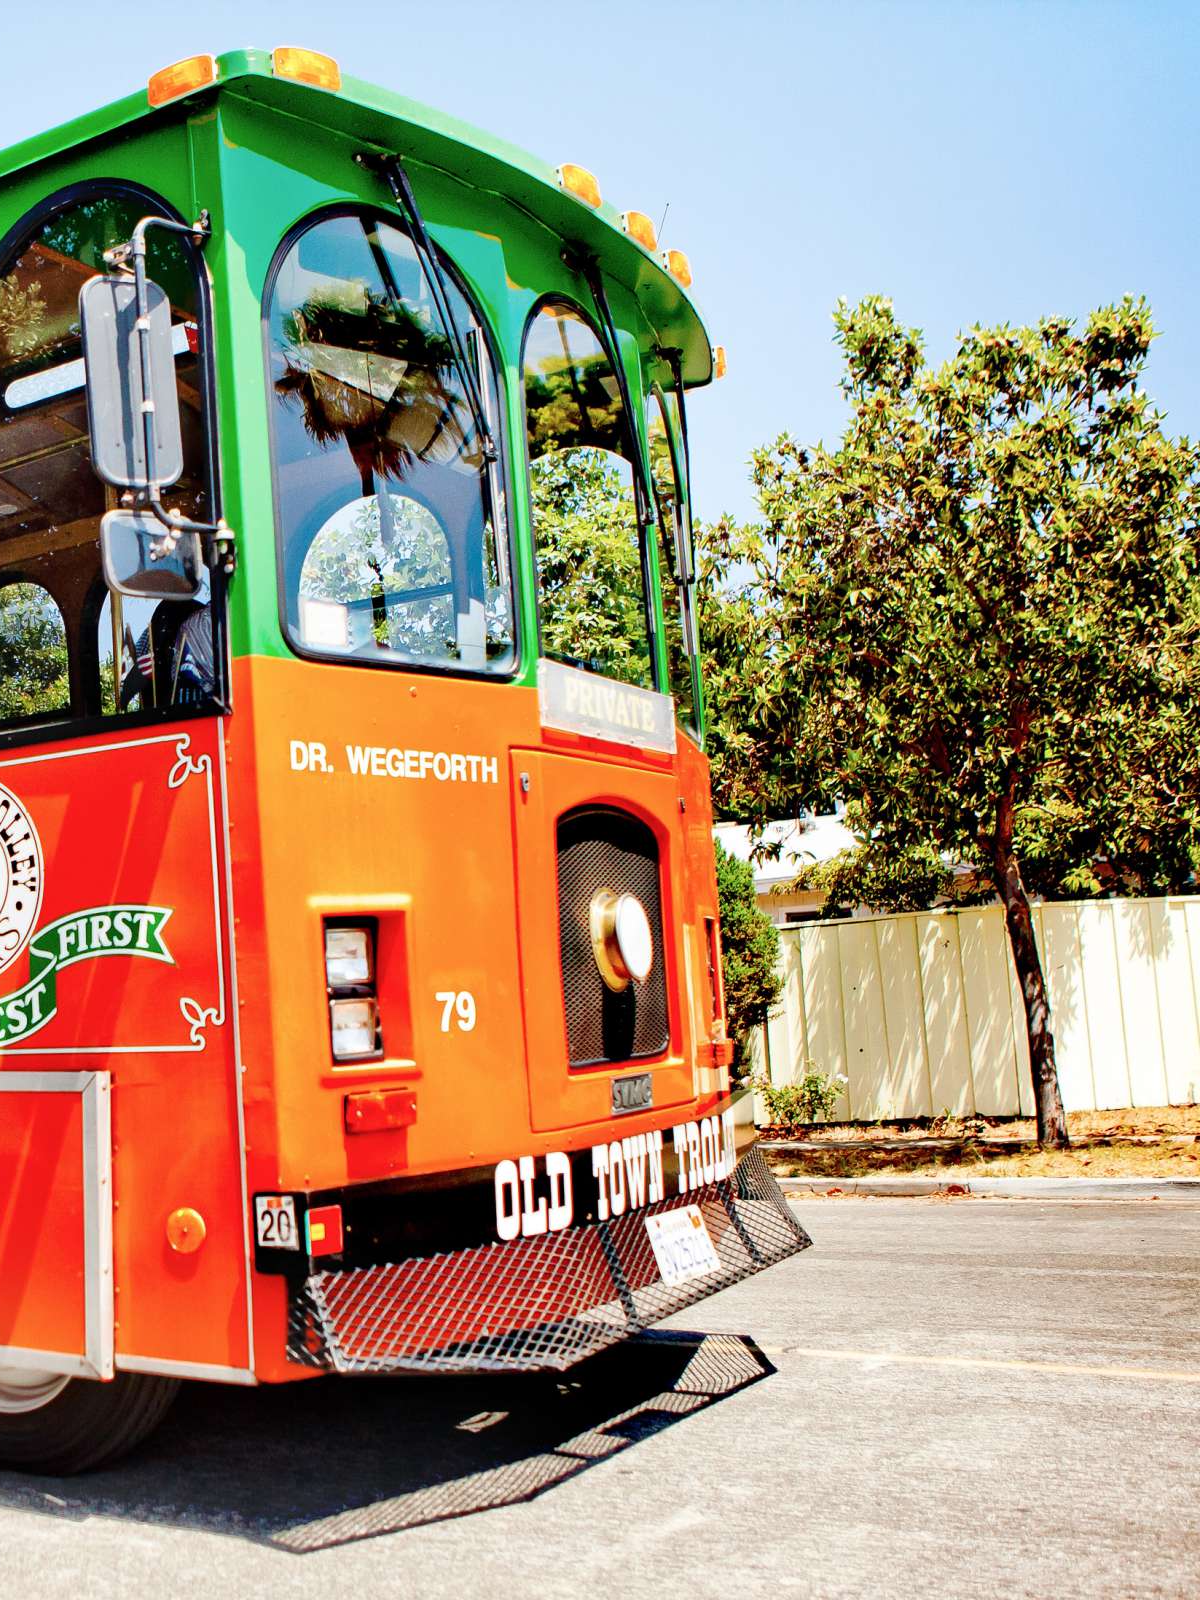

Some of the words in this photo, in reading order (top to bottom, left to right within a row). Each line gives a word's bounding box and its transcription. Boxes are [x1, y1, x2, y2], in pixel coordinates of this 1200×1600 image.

[564, 676, 656, 732] PRIVATE
[289, 740, 334, 774] DR.
[347, 744, 499, 784] WEGEFORTH
[56, 911, 157, 961] FIRST
[434, 990, 477, 1033] 79
[494, 1151, 573, 1241] OLD
[591, 1129, 665, 1221] TOWN
[261, 1209, 291, 1242] 20
